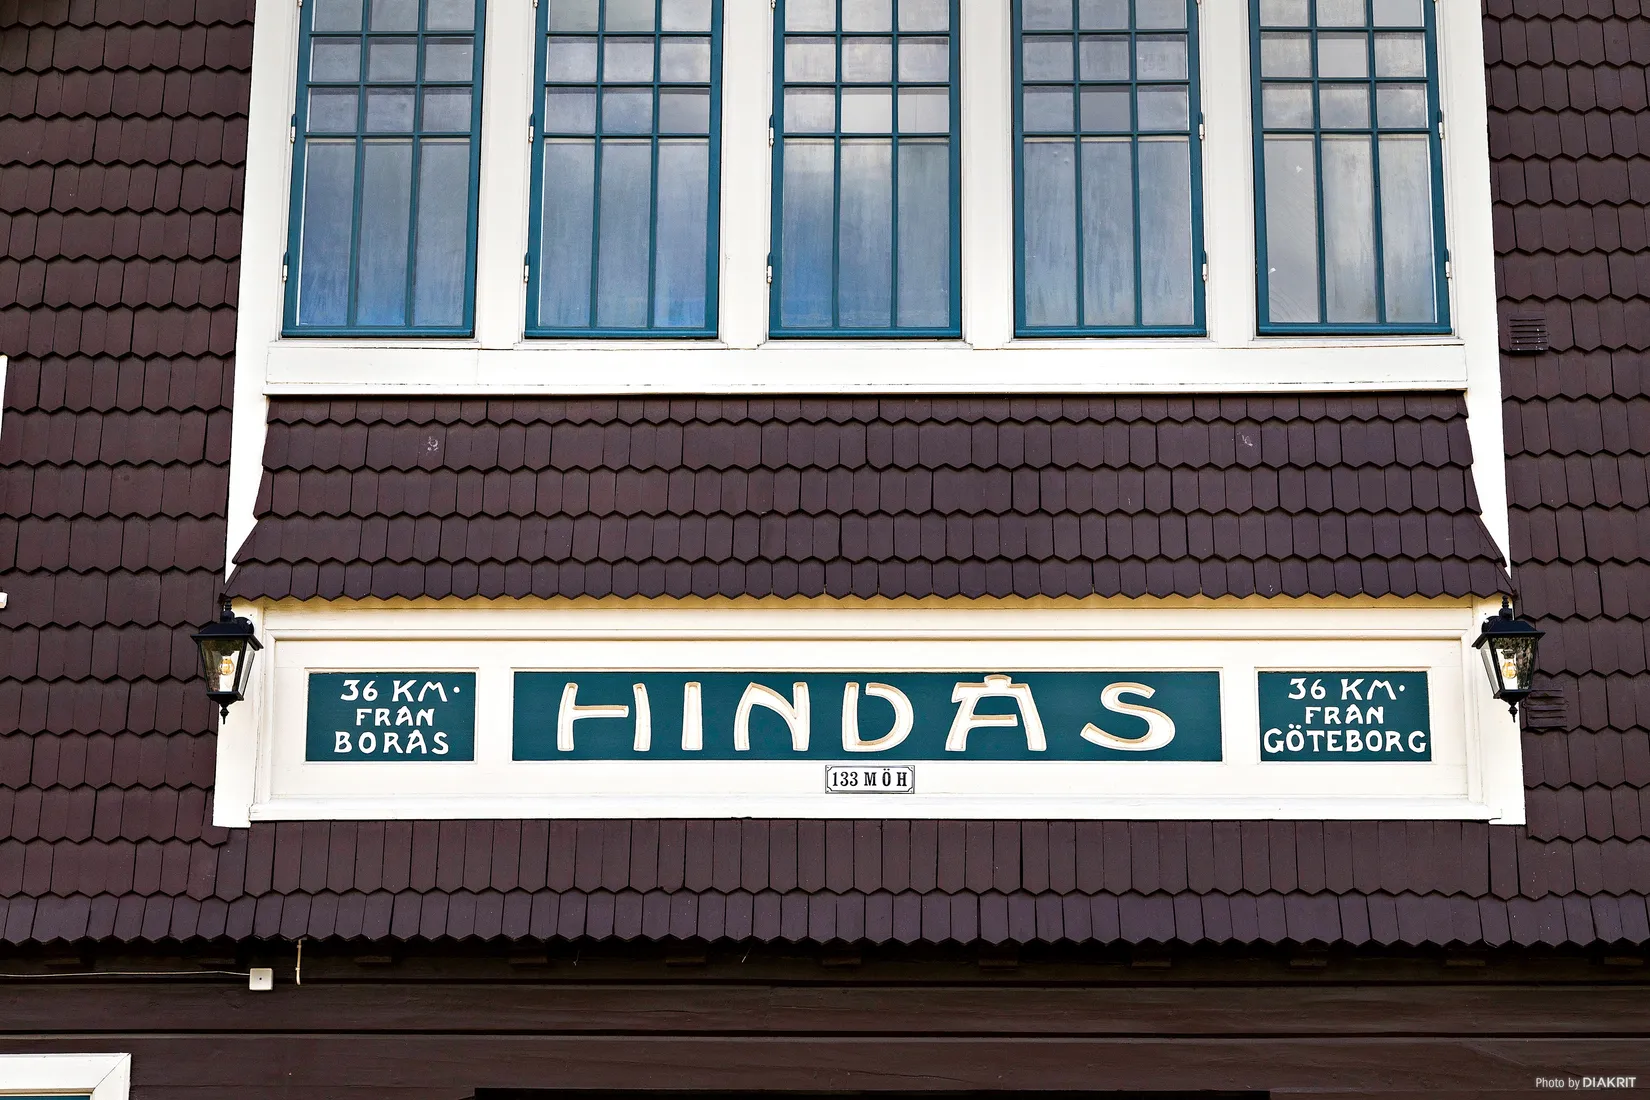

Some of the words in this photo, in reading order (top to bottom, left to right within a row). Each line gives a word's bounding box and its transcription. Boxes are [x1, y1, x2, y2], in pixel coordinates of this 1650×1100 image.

[340, 679, 379, 702] 36
[1287, 677, 1327, 700] 36
[355, 705, 435, 727] FRÅN
[556, 674, 1176, 753] HINDÅS
[1305, 703, 1384, 725] FRÅN
[333, 729, 449, 755] BORÅS
[1263, 723, 1427, 754] GÖTEBORG
[832, 771, 859, 787] 133
